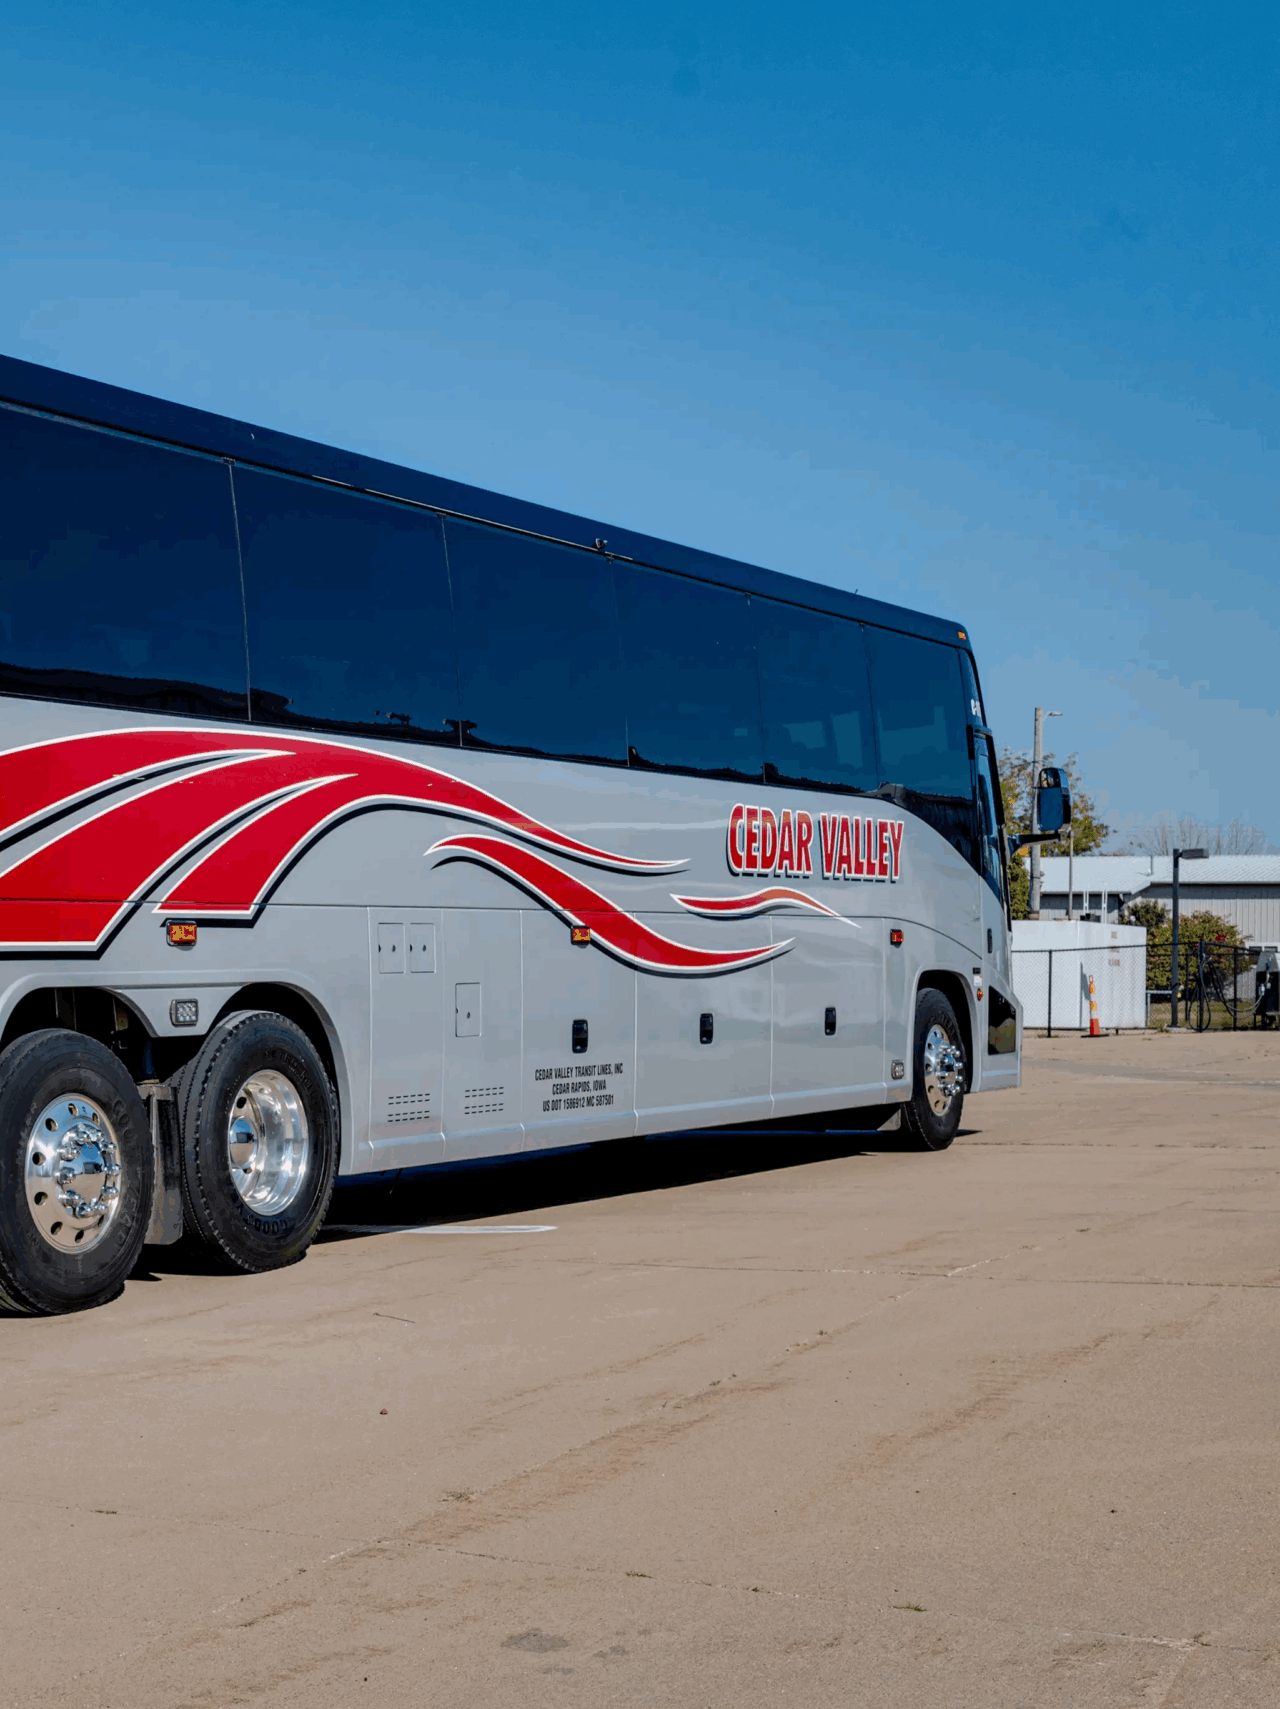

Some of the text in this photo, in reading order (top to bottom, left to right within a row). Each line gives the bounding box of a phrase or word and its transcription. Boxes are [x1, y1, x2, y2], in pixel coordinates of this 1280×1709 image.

[726, 803, 905, 884] CEDAR VALLEY
[534, 1068, 553, 1081] CEDAR
[554, 1066, 573, 1079] VALLEY
[575, 1064, 596, 1077] TRANSIT
[614, 1062, 623, 1075] INC
[552, 1079, 607, 1095] CEDAR RAPIDS, IOWA
[542, 1100, 550, 1112] US
[551, 1098, 562, 1111] DOT
[586, 1095, 595, 1107] MC
